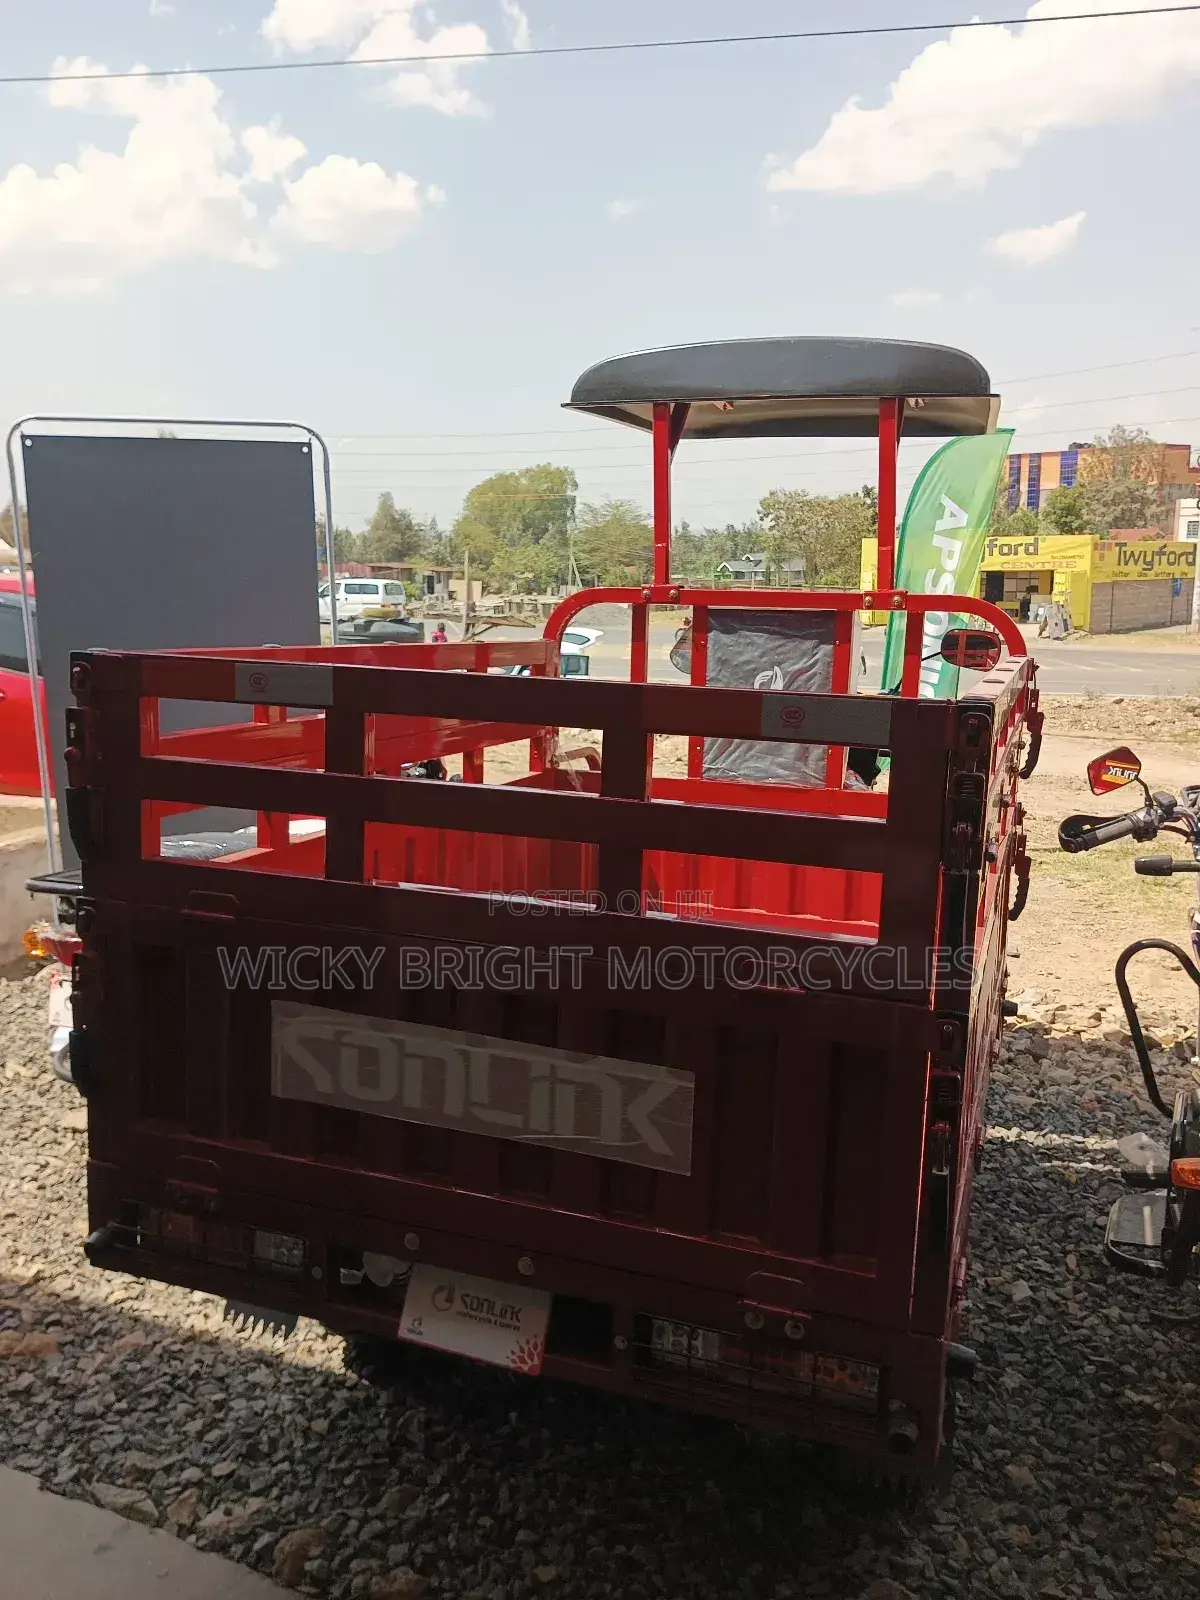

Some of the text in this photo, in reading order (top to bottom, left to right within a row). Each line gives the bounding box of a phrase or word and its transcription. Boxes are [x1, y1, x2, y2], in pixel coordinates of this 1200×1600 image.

[983, 537, 1040, 558] ford
[1114, 541, 1197, 572] Twyford
[999, 560, 1077, 570] CENTRE
